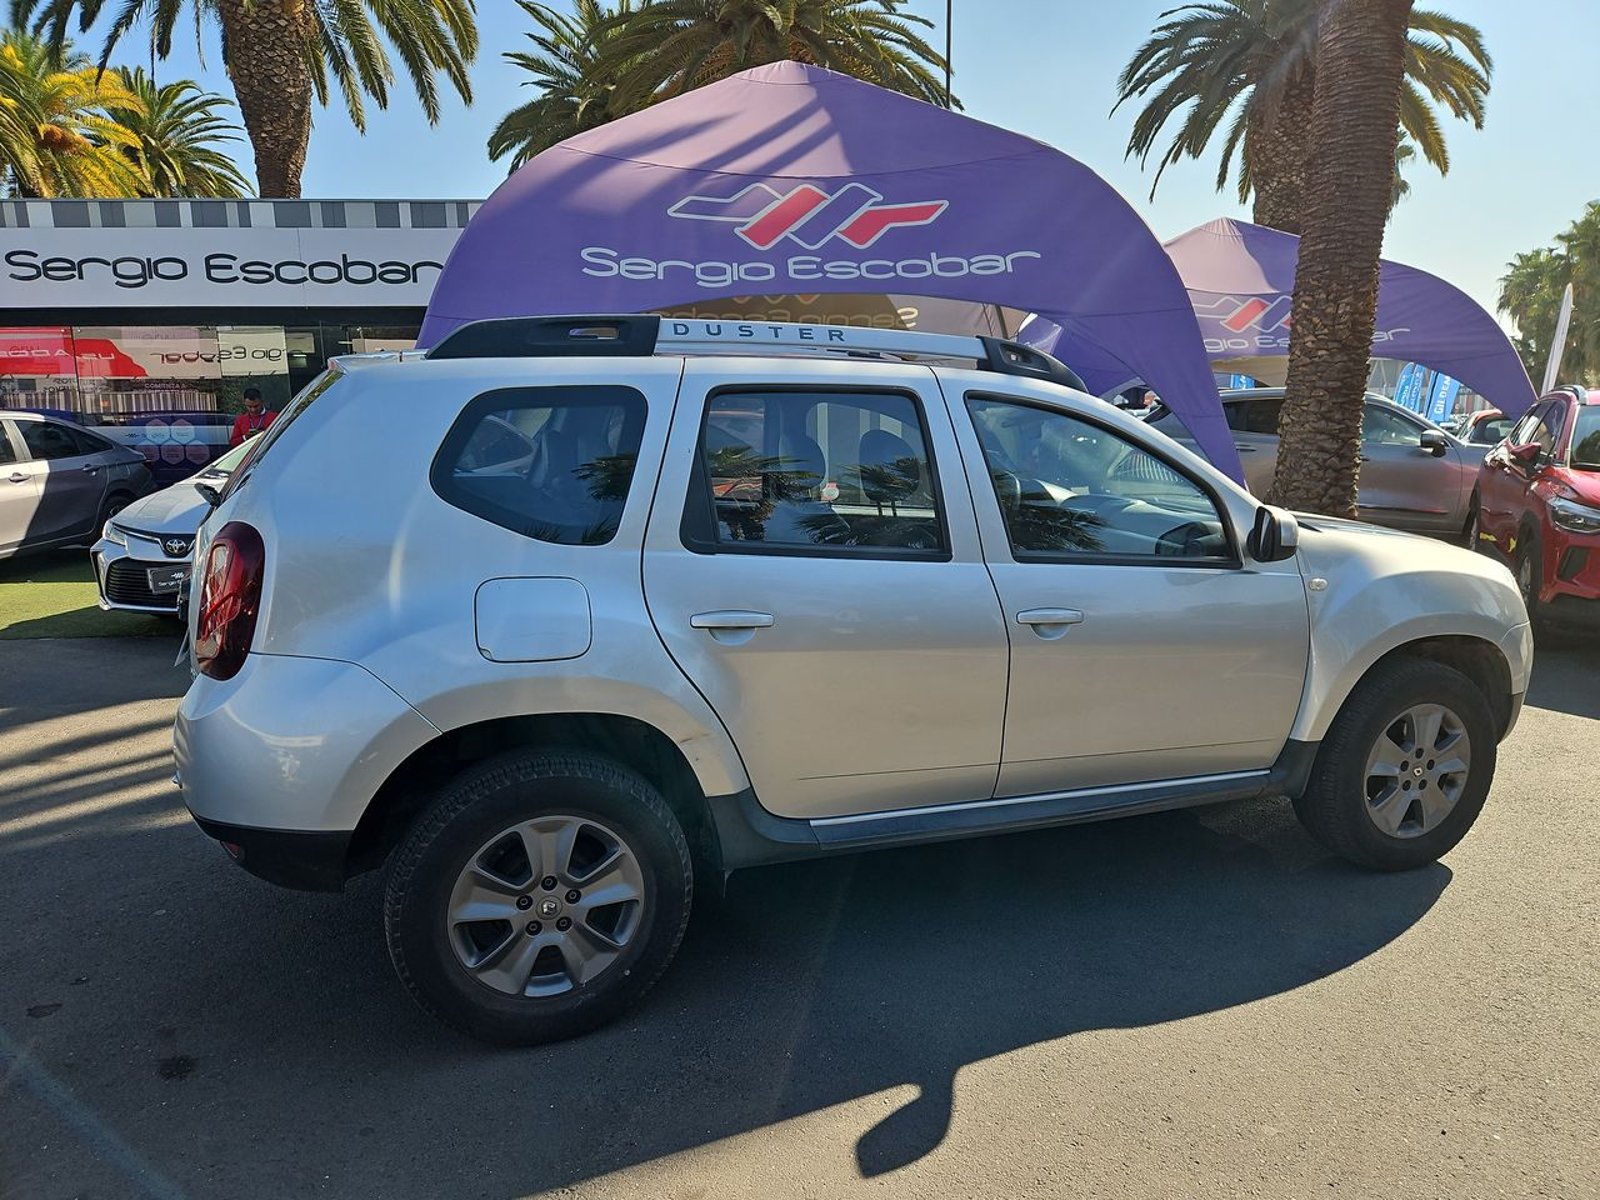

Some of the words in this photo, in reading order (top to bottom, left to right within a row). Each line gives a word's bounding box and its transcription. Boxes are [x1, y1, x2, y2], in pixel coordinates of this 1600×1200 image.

[4, 250, 189, 289] Sergio
[204, 253, 445, 284] Escobar
[580, 246, 776, 288] Sergio
[787, 250, 1042, 280] Escobar
[673, 323, 847, 342] DUSTER
[1203, 338, 1250, 353] gio
[1434, 376, 1451, 415] GILDEM
